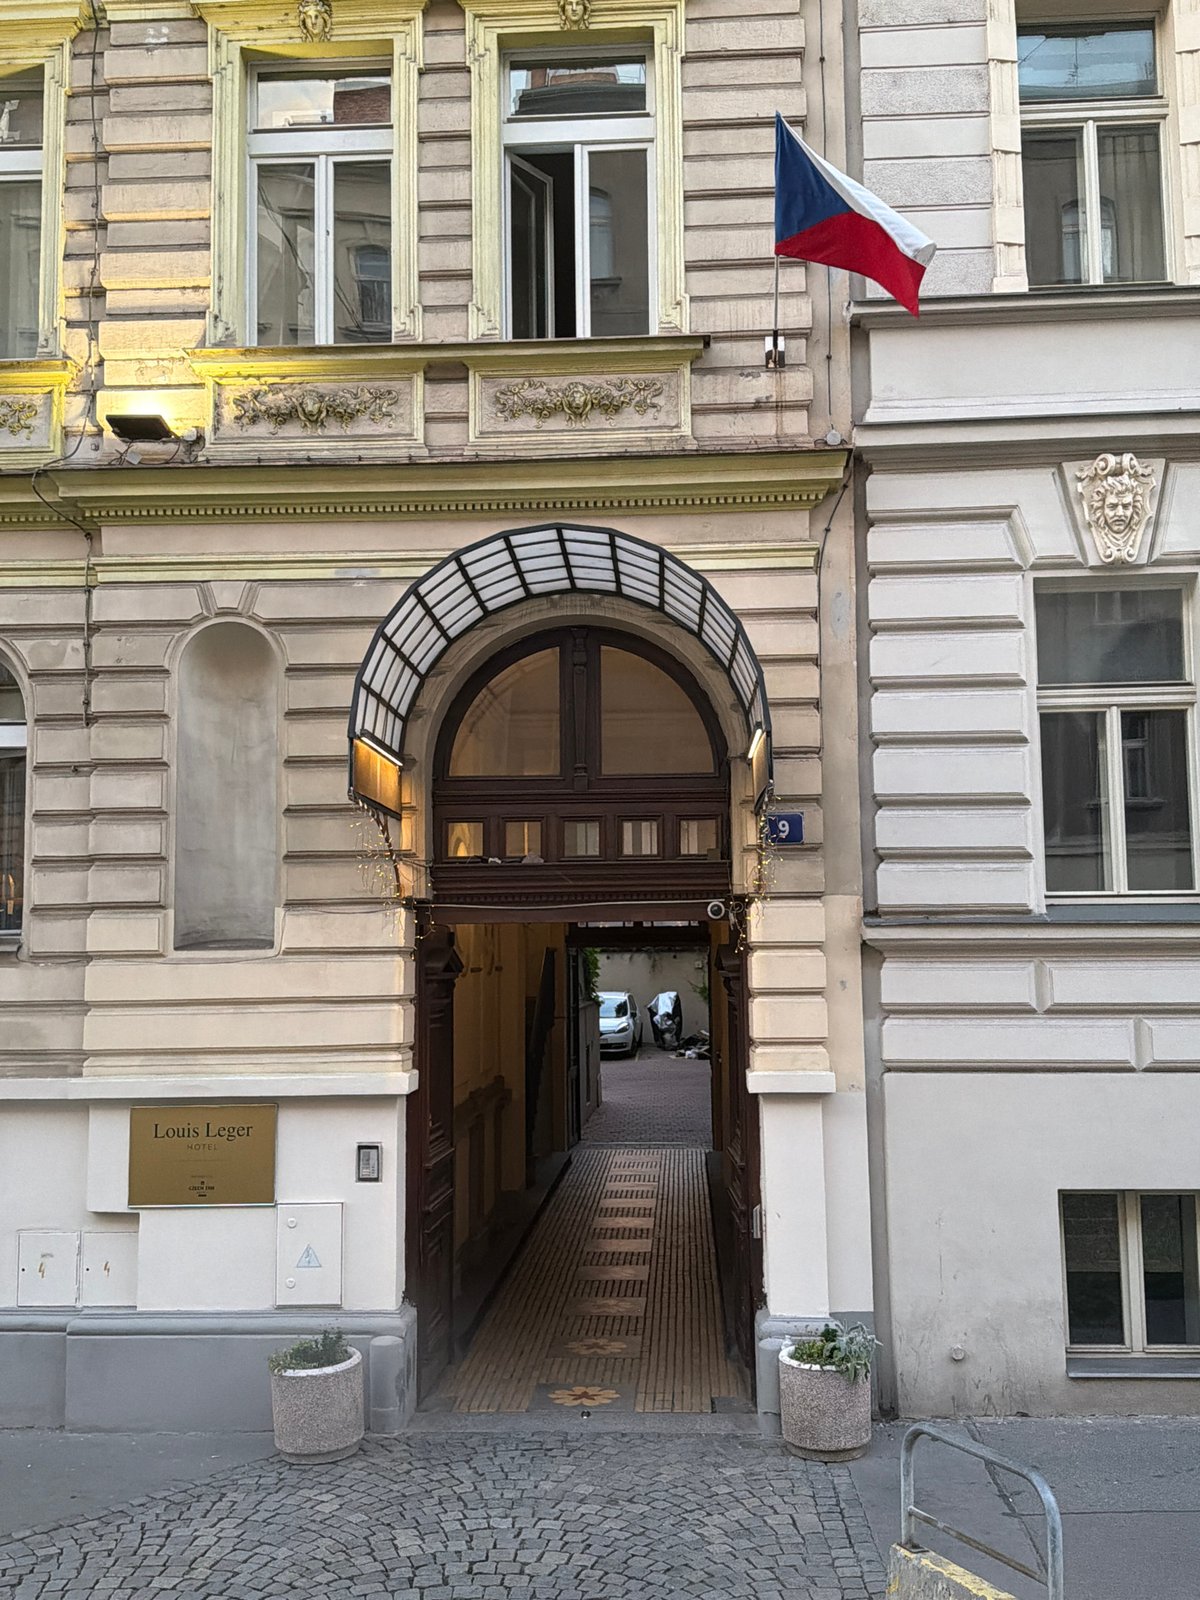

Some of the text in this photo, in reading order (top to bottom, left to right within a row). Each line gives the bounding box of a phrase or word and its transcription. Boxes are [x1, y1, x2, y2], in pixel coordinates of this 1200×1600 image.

[778, 820, 790, 837] 9
[153, 1122, 253, 1141] Louis Leger
[187, 1143, 217, 1151] HOTEL
